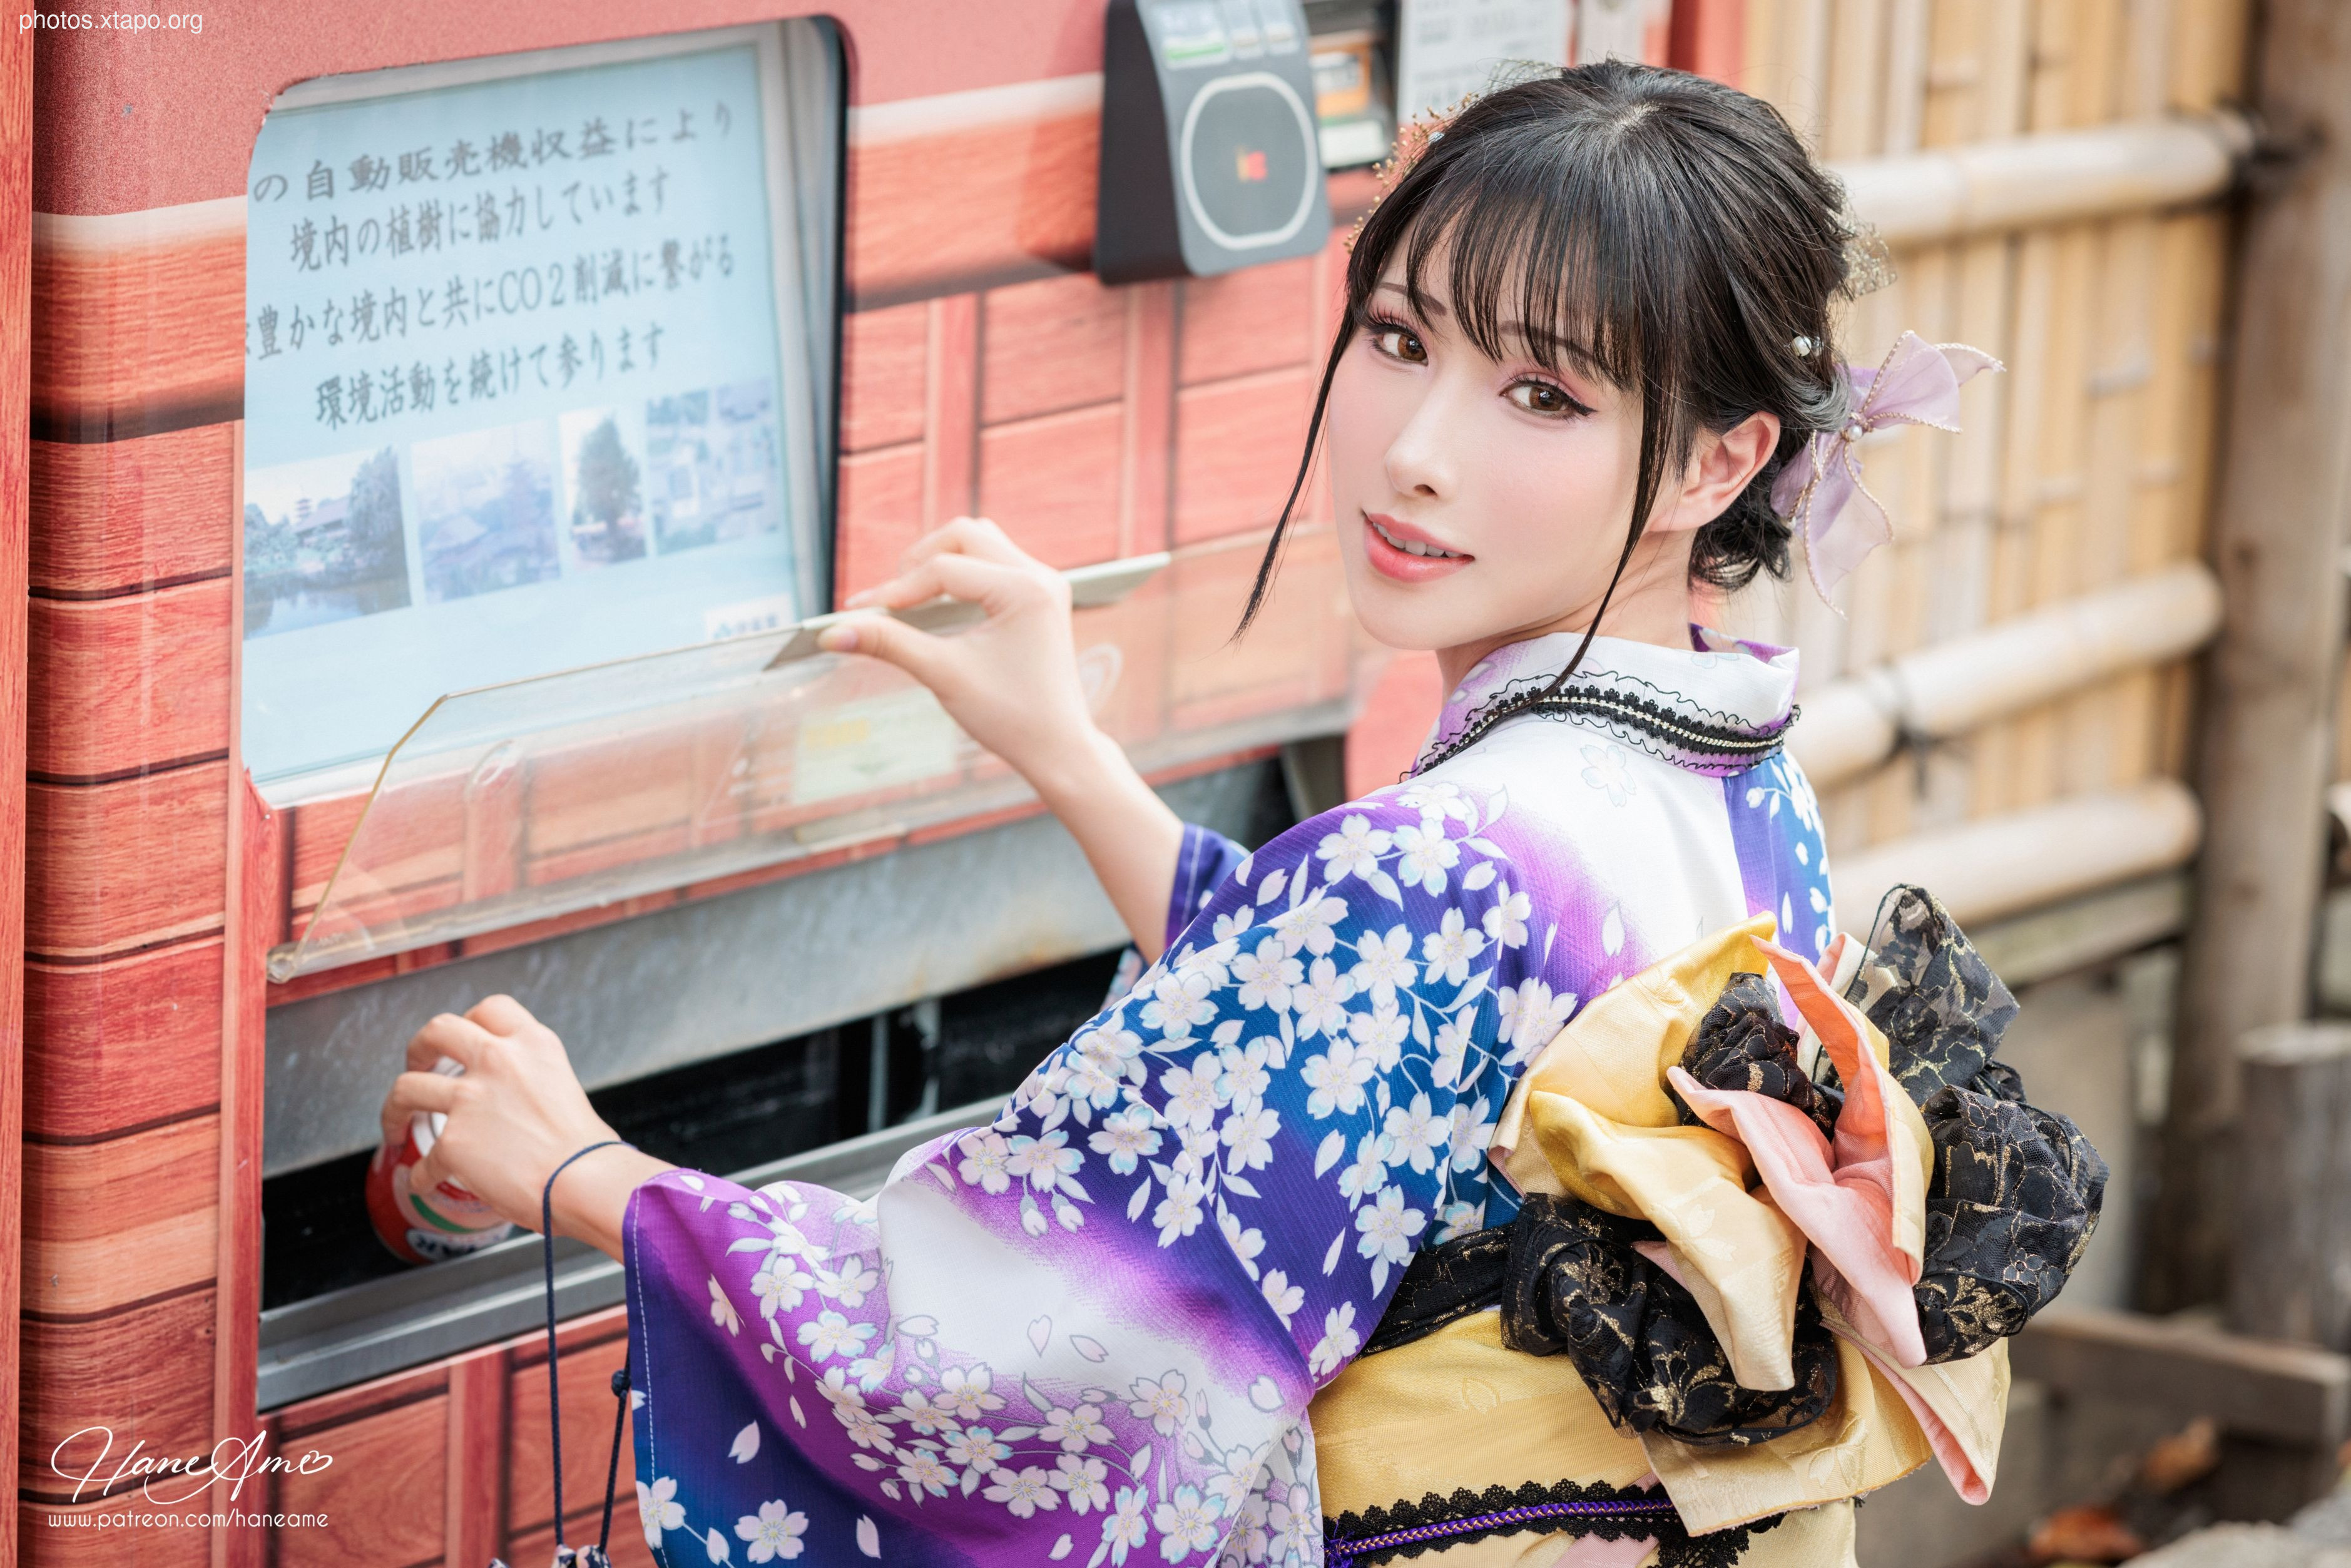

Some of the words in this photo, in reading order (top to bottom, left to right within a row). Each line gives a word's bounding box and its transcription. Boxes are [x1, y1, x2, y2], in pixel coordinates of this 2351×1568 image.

[290, 165, 669, 273] 境内の植樹に協力しています
[247, 233, 733, 360] 豊かな境内と共にCO2削減に繋がる
[316, 321, 664, 430] 環境活動を続けて参ります
